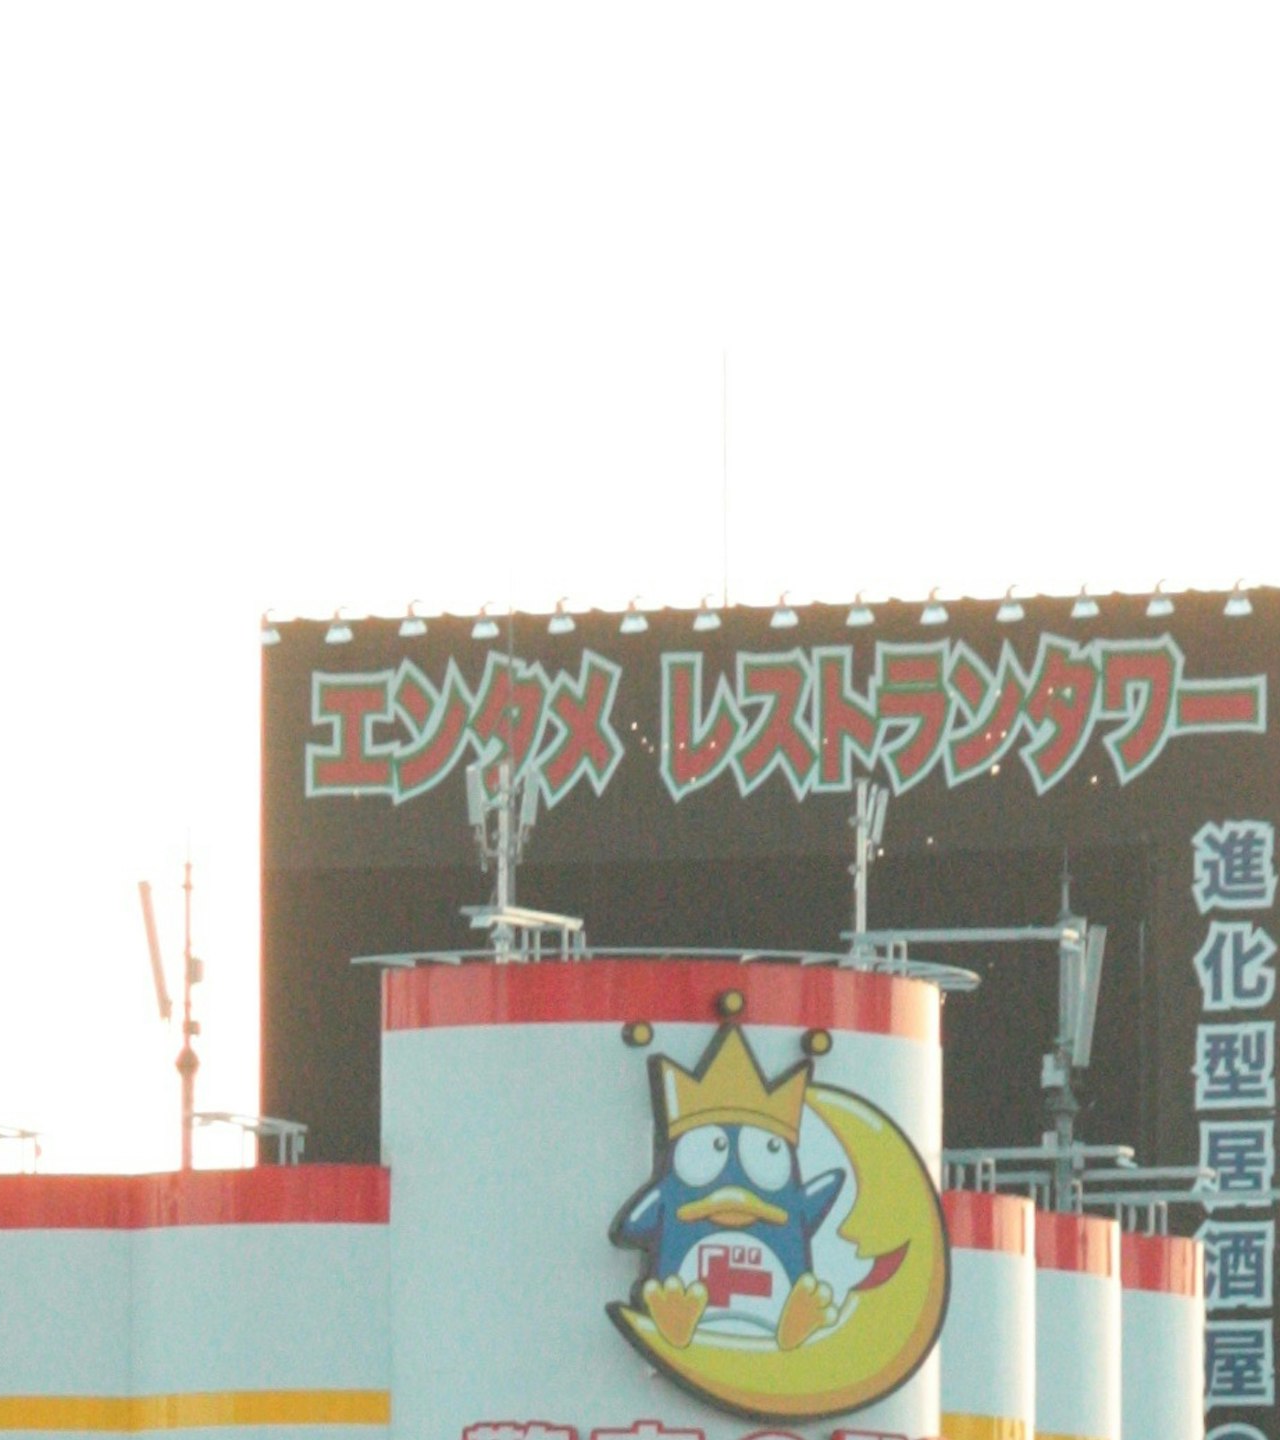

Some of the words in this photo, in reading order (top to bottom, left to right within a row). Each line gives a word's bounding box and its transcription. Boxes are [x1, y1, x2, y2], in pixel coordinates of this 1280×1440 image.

[306, 651, 624, 805] エンタメ
[660, 635, 1266, 800] レストランタワー
